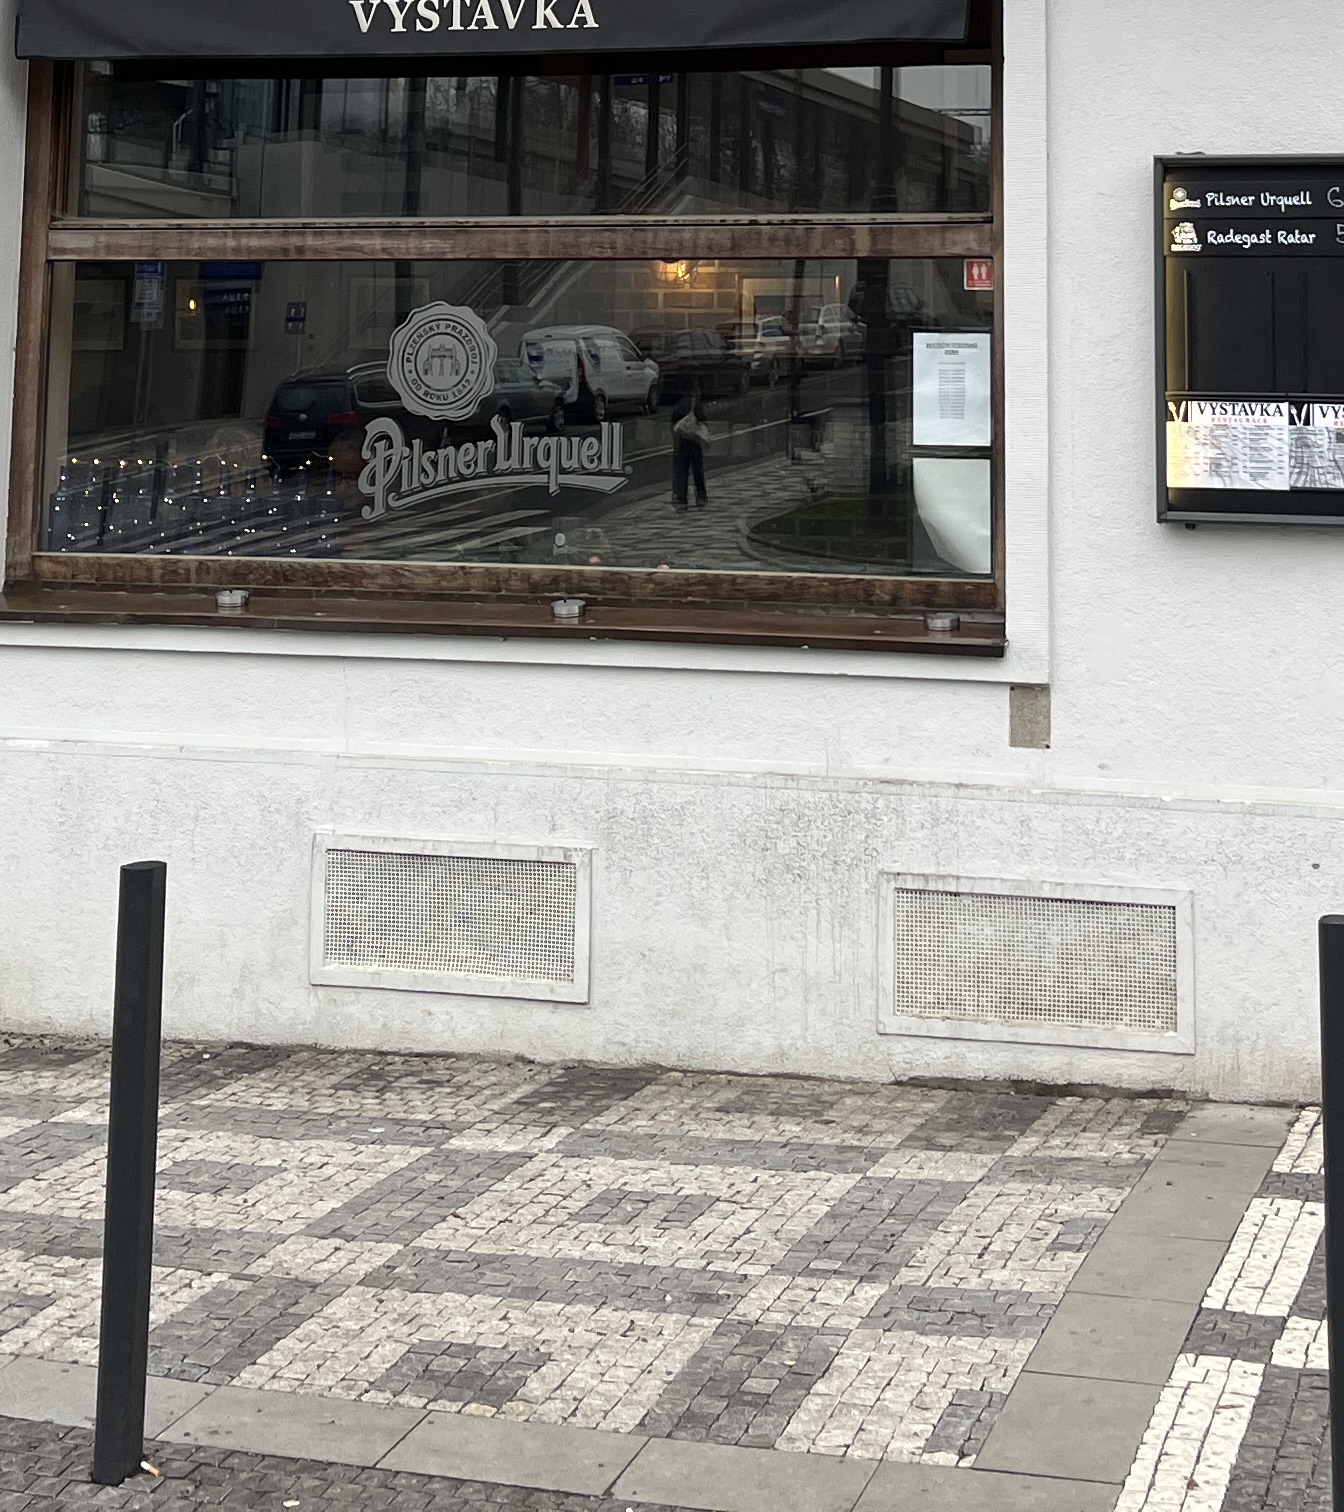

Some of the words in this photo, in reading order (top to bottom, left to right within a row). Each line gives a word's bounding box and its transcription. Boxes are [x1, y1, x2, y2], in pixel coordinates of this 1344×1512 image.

[1205, 191, 1255, 207] Pilsner
[1260, 191, 1312, 212] Urquell
[1207, 231, 1272, 249] Radegast
[358, 417, 495, 522] Pilsner
[490, 414, 624, 497] Urquell
